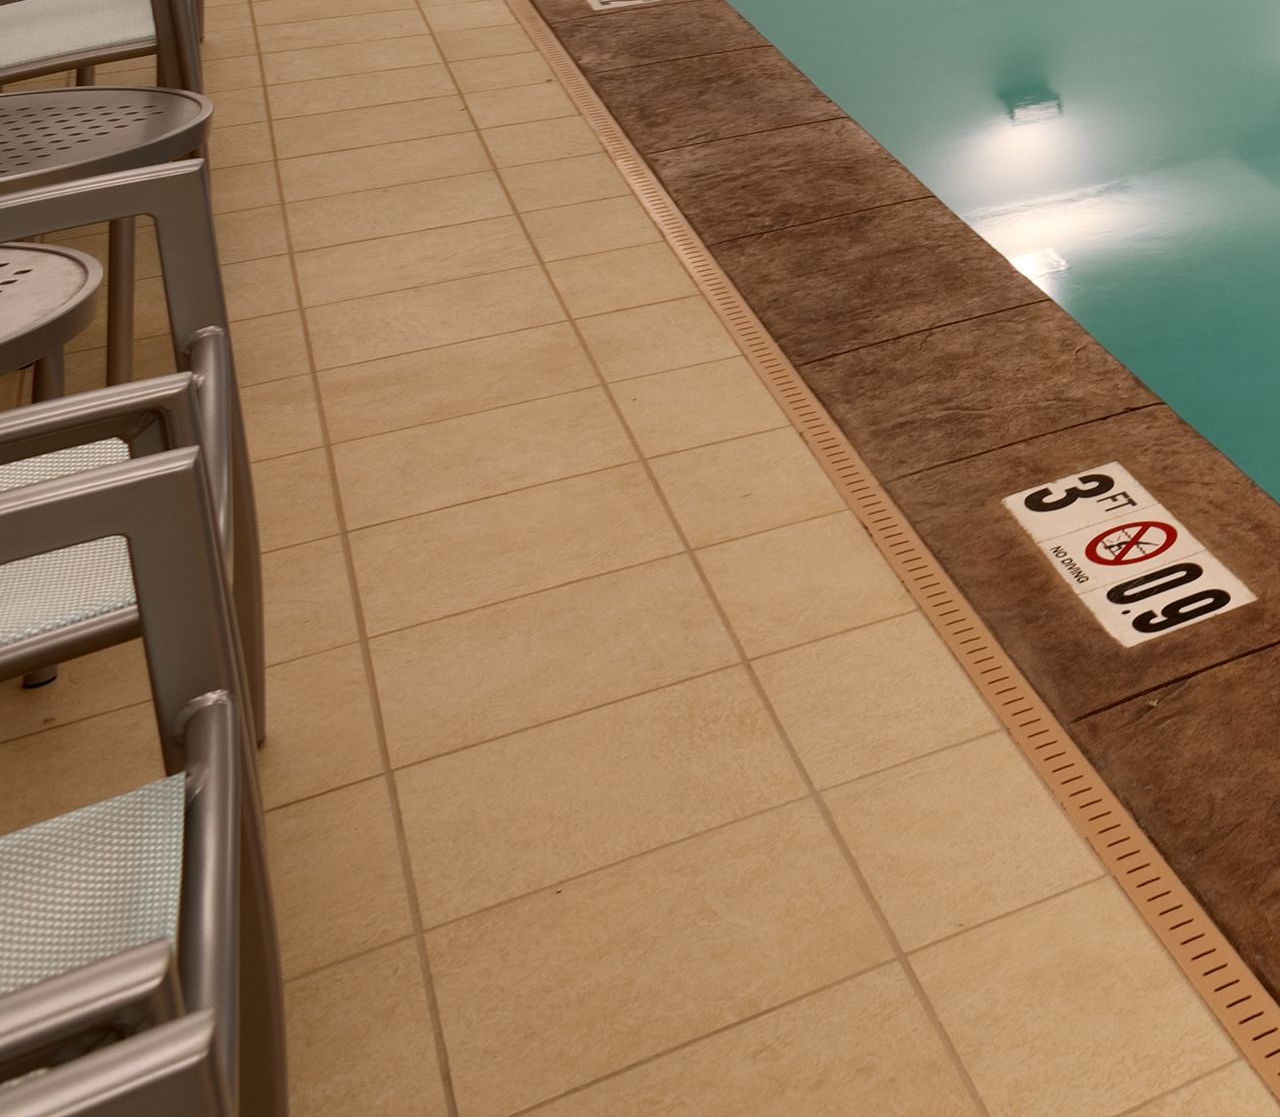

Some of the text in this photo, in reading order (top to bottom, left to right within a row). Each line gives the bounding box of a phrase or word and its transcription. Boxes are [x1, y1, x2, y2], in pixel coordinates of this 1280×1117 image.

[1024, 473, 1115, 513] 3
[1096, 491, 1137, 513] FT
[1050, 545, 1090, 585] NO DIVING
